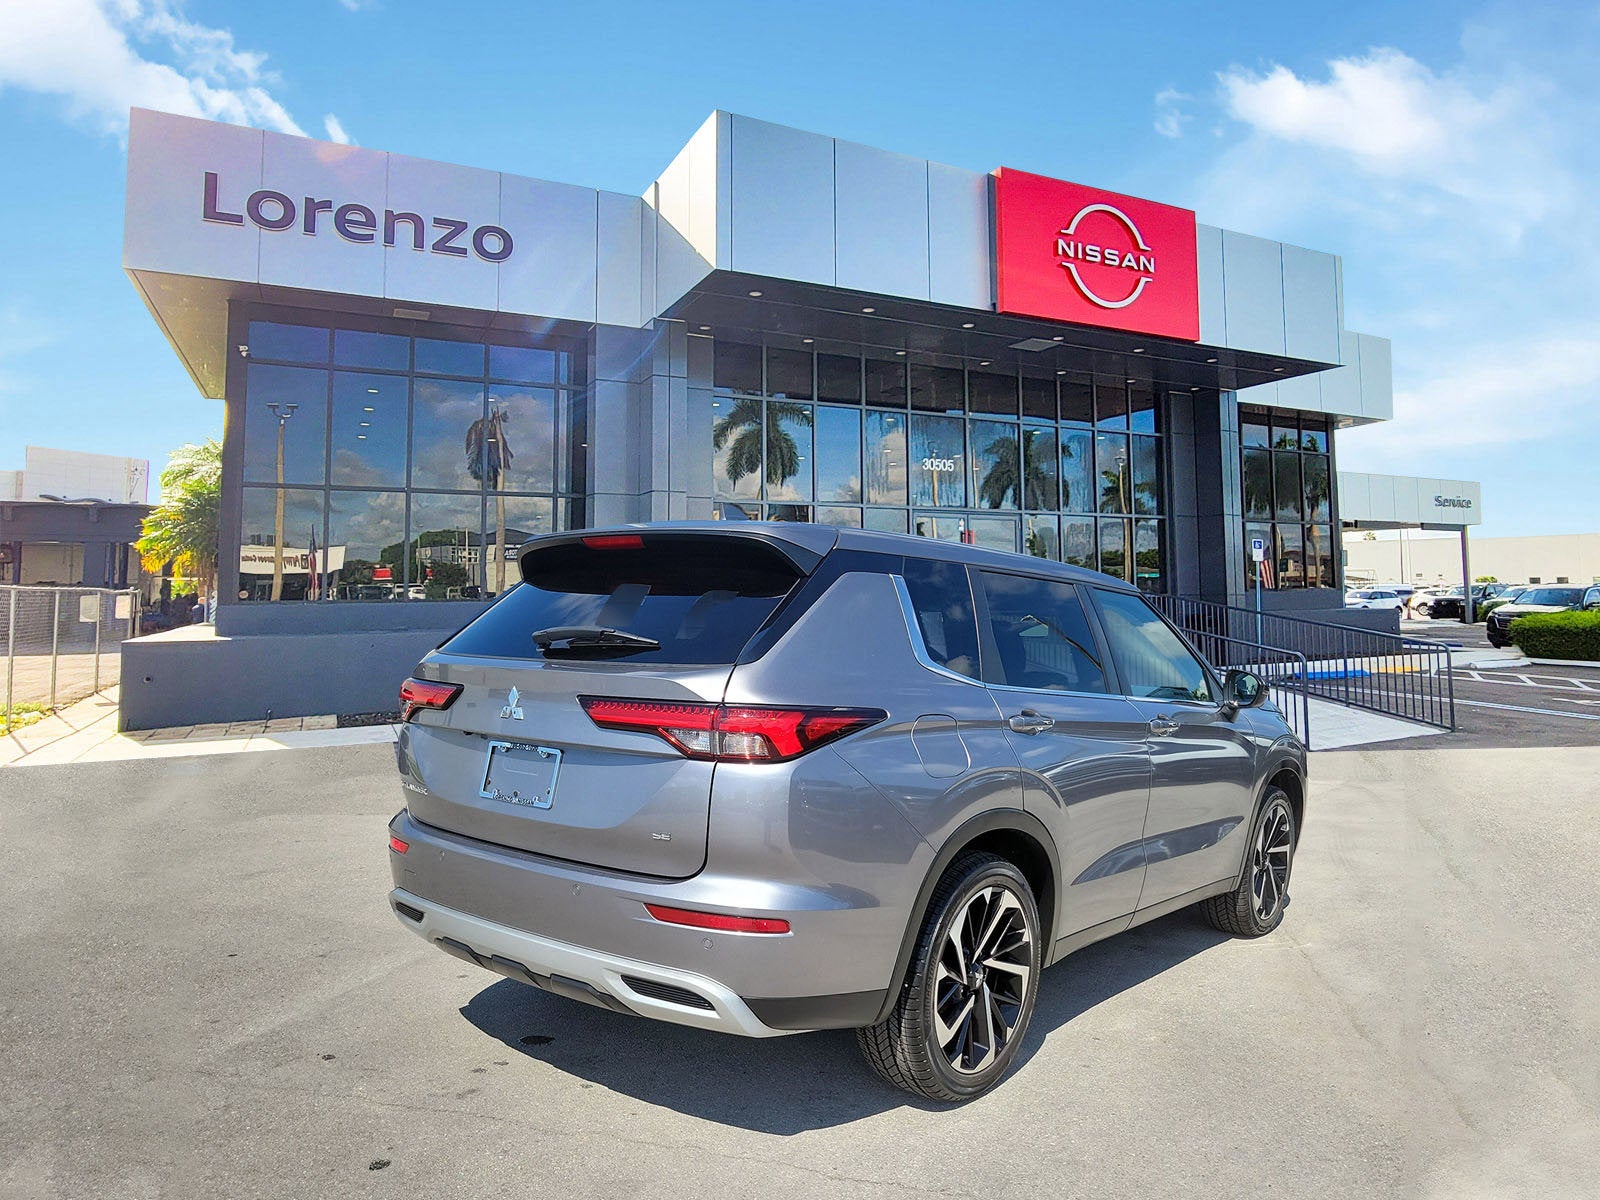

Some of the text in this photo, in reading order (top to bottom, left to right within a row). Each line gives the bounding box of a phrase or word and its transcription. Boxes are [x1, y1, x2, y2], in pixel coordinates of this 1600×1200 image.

[202, 171, 514, 262] Lorenzo
[1057, 238, 1155, 273] NISSAN
[922, 457, 955, 472] 30505
[1434, 495, 1472, 509] Service
